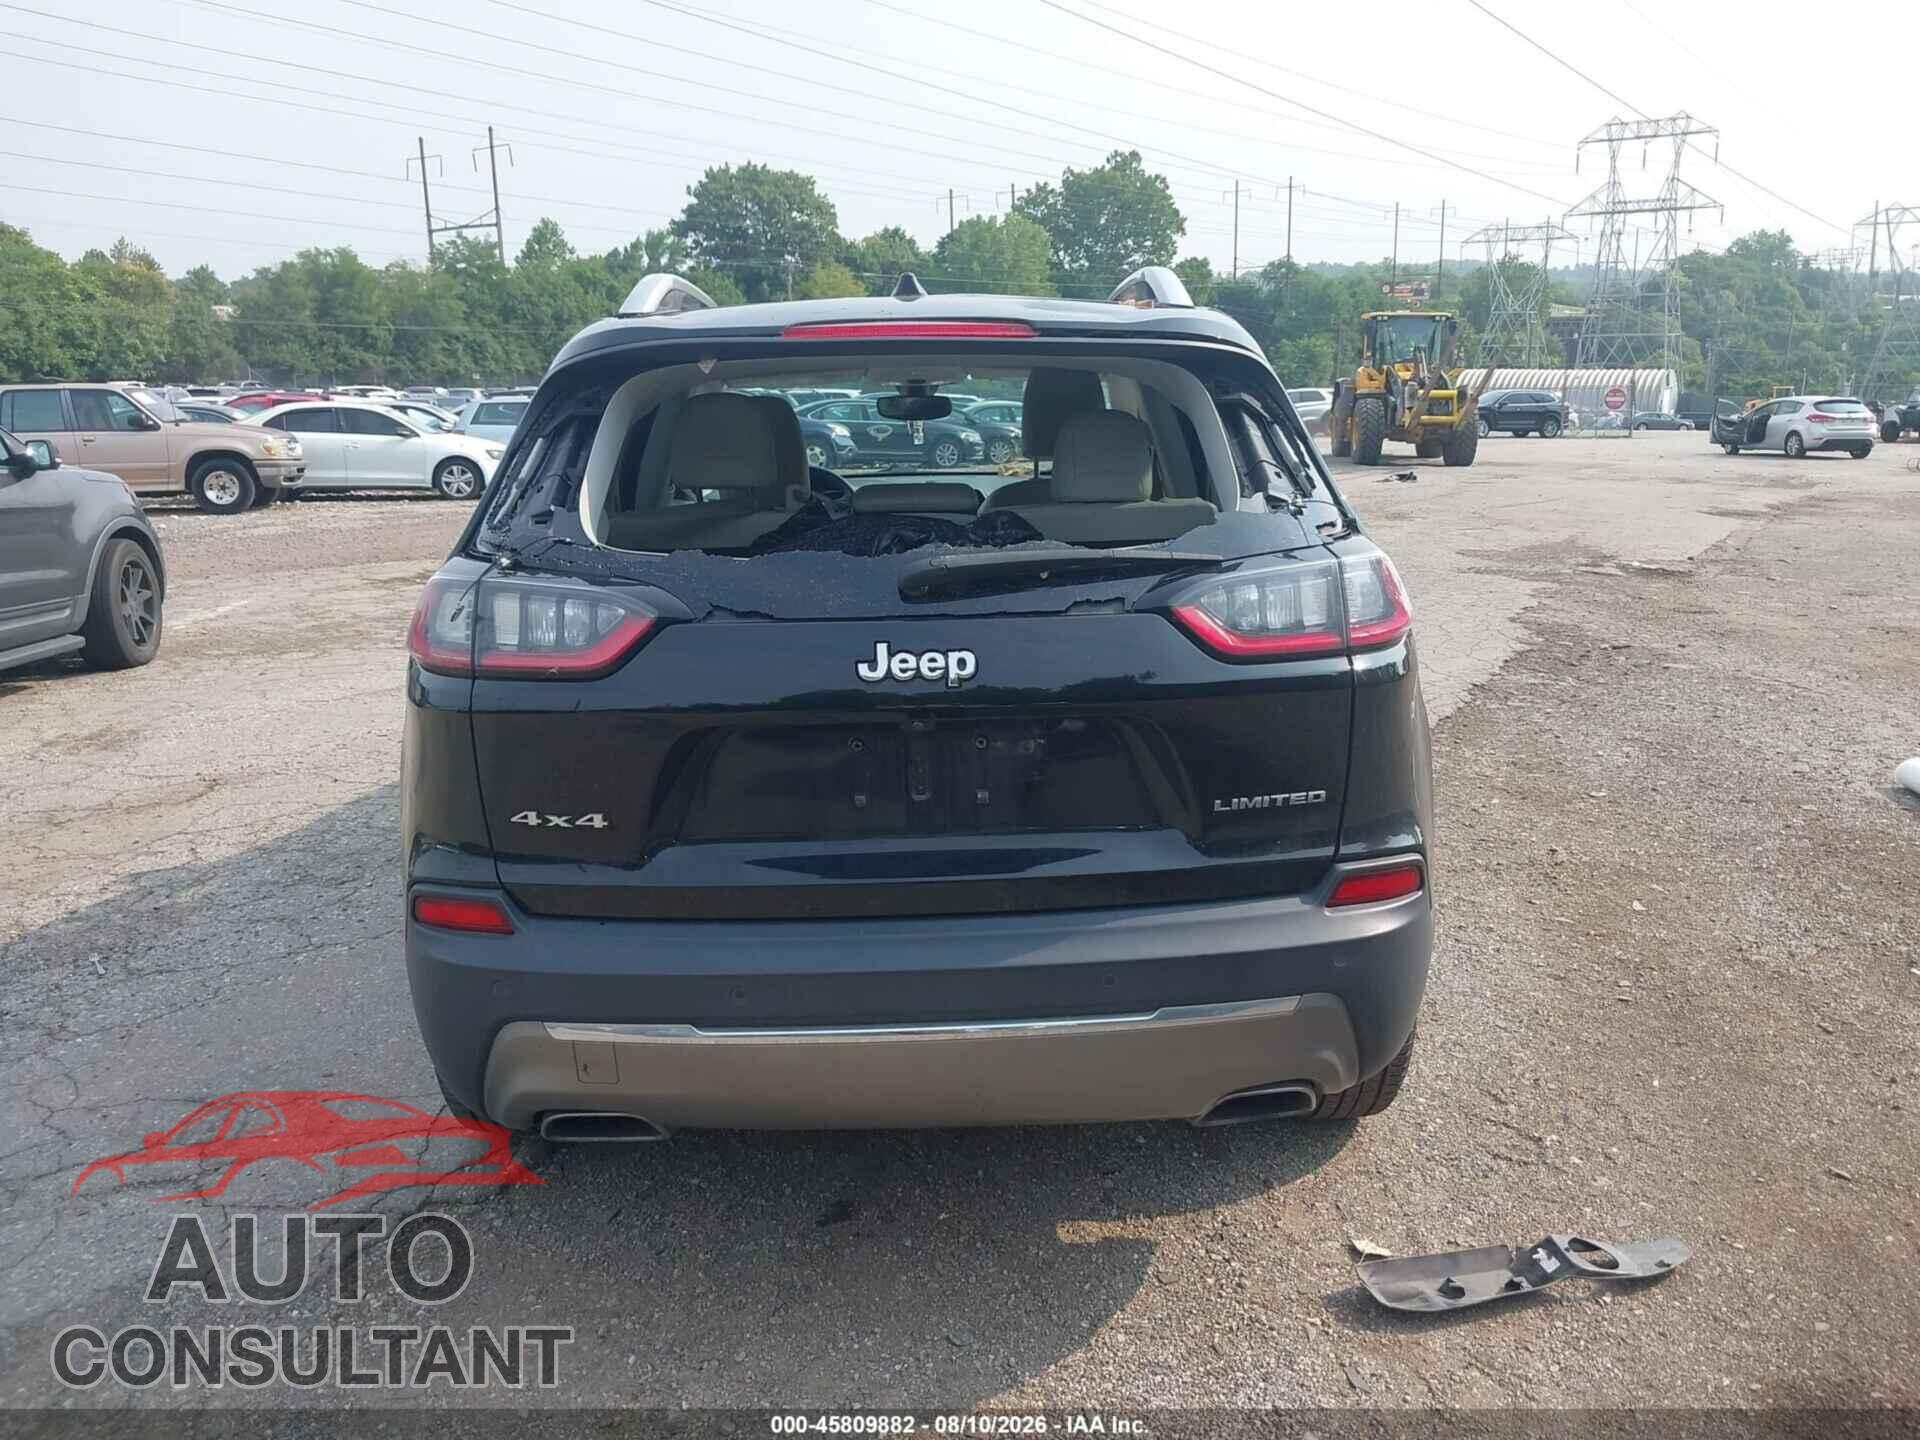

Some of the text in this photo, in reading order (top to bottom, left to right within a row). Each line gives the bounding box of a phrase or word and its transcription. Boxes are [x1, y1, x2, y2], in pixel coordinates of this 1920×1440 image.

[856, 641, 978, 687] Jeep
[1213, 790, 1327, 812] LIMITED
[510, 811, 609, 829] 4x4
